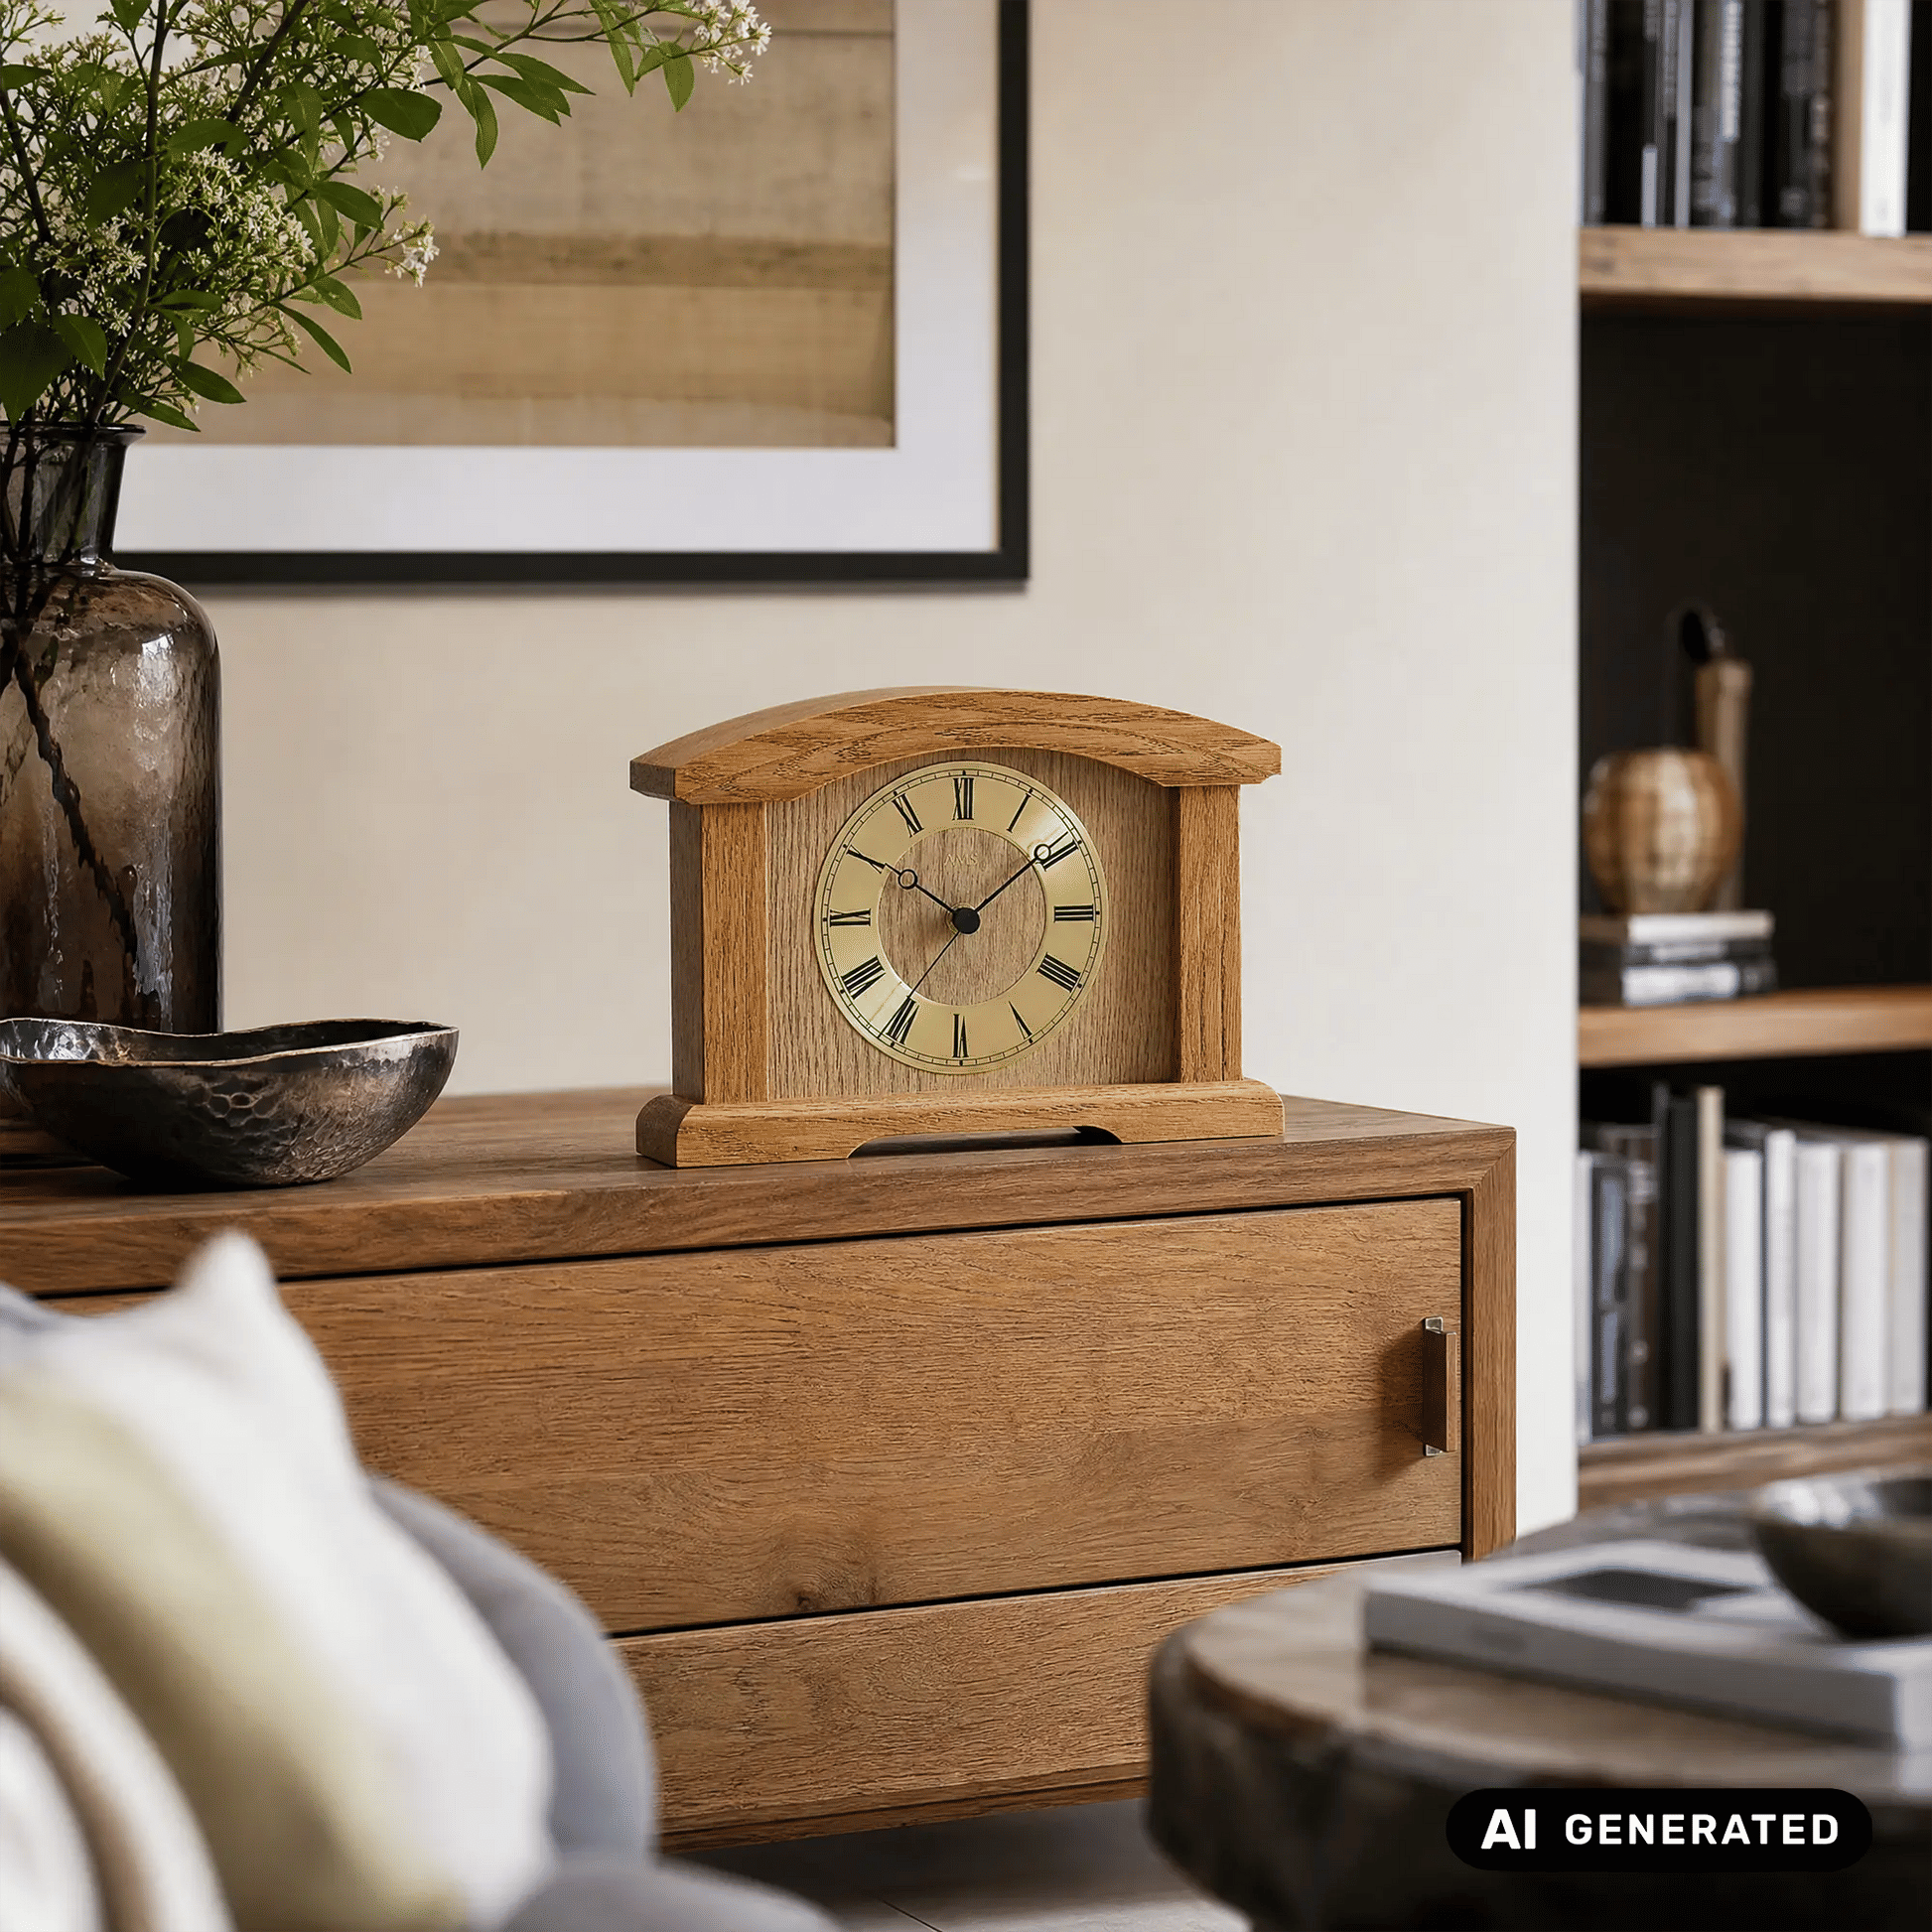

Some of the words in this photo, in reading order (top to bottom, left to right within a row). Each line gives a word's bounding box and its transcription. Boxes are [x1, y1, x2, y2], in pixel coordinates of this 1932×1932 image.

[892, 793, 924, 838] XI
[952, 777, 974, 820] XII
[1006, 793, 1032, 833] I
[847, 844, 886, 874] X
[944, 853, 978, 866] AMS
[1038, 839, 1079, 872] II
[829, 908, 871, 927] IX
[1053, 903, 1094, 923] III
[840, 955, 887, 1001] VIII
[1035, 952, 1081, 993] IIII
[886, 996, 919, 1044] VII
[952, 1014, 969, 1058] VI
[1009, 1001, 1033, 1040] V
